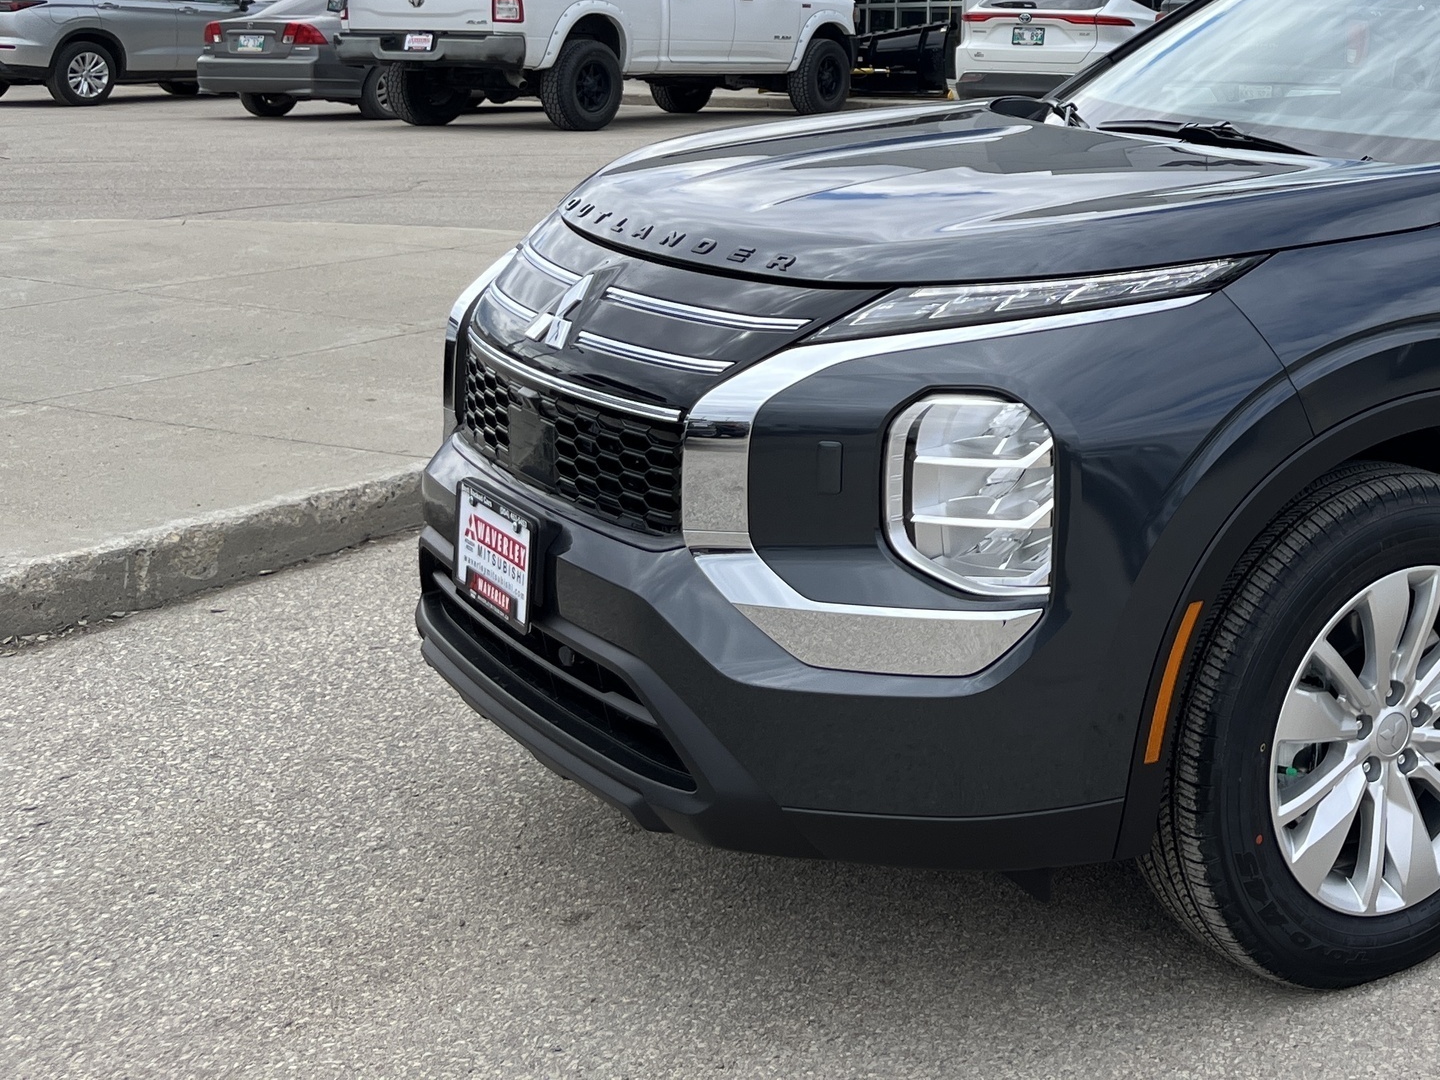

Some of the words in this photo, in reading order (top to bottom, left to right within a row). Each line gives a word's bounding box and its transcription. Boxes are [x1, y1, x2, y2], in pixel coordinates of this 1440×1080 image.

[564, 196, 797, 271] OUTLANDER
[477, 519, 526, 567] WAVERLEY
[477, 544, 525, 586] MITSUBISHI
[478, 577, 510, 610] WAVERLEY
